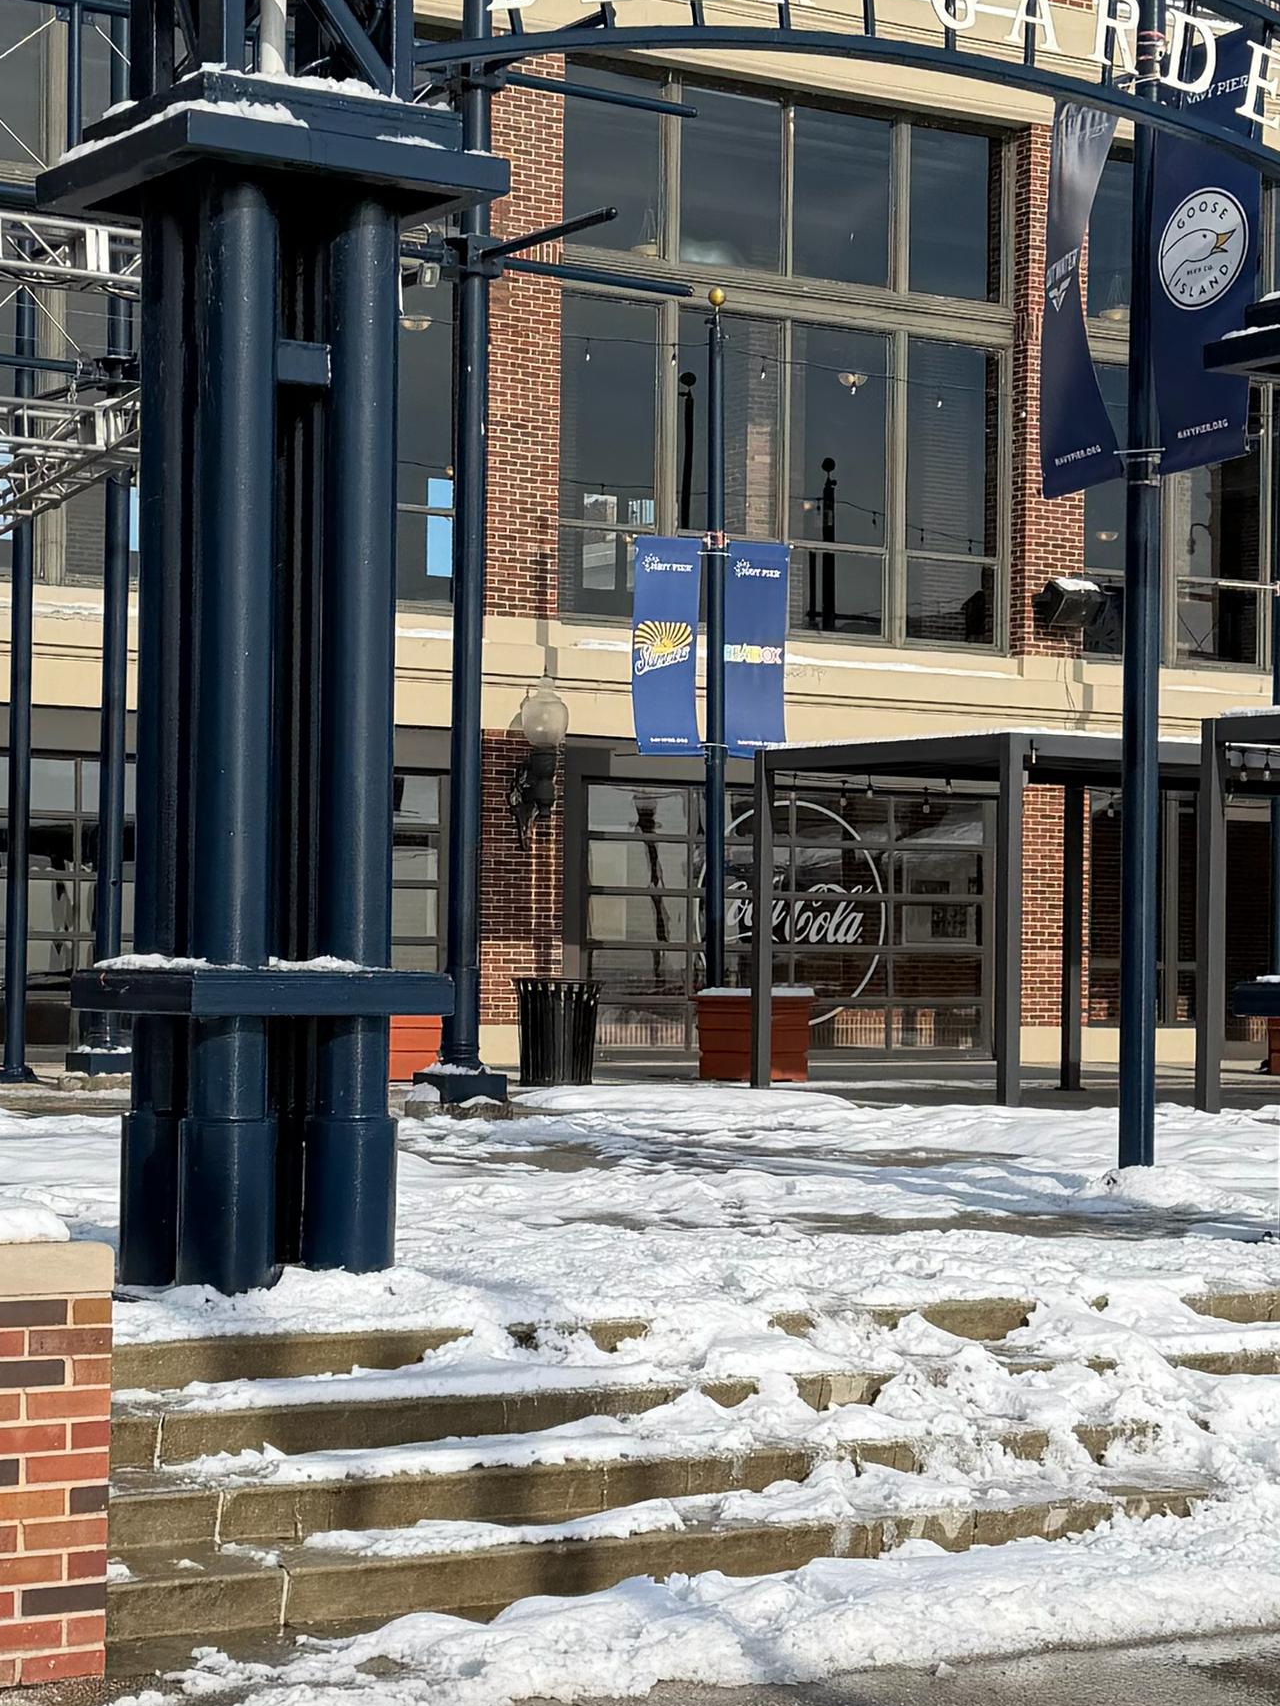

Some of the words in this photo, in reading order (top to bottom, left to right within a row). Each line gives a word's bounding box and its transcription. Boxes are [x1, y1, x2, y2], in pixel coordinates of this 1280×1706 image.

[1216, 75, 1249, 95] PIER
[1176, 200, 1228, 229] GOOSE
[1174, 264, 1229, 297] ISLAND
[723, 881, 873, 944] oc-Cola
